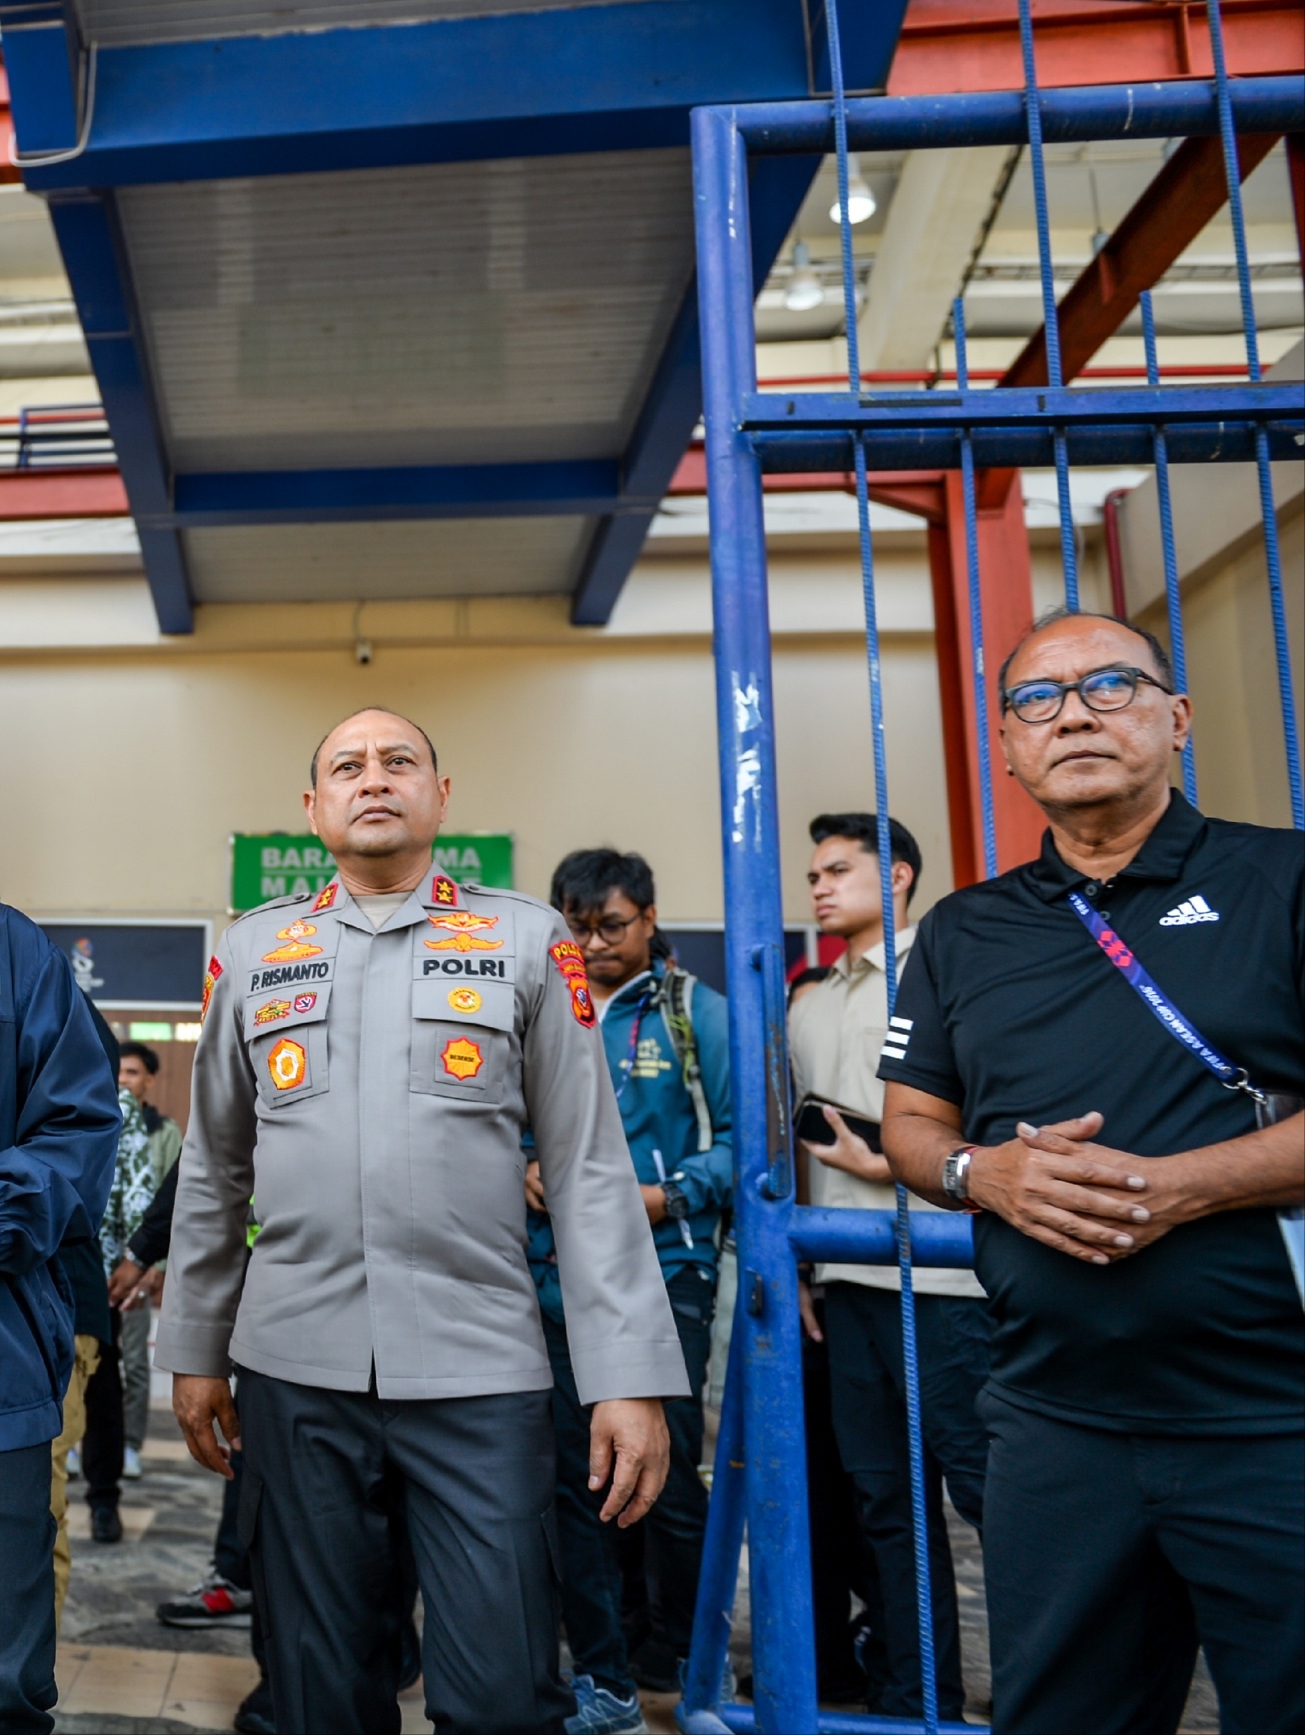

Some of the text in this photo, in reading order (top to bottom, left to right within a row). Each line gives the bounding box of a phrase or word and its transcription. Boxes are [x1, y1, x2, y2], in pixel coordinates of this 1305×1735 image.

[1159, 912, 1220, 926] adidas
[261, 962, 329, 988] RISMANTO
[423, 959, 505, 978] POLRI
[1169, 1018, 1205, 1049] ASEAN
